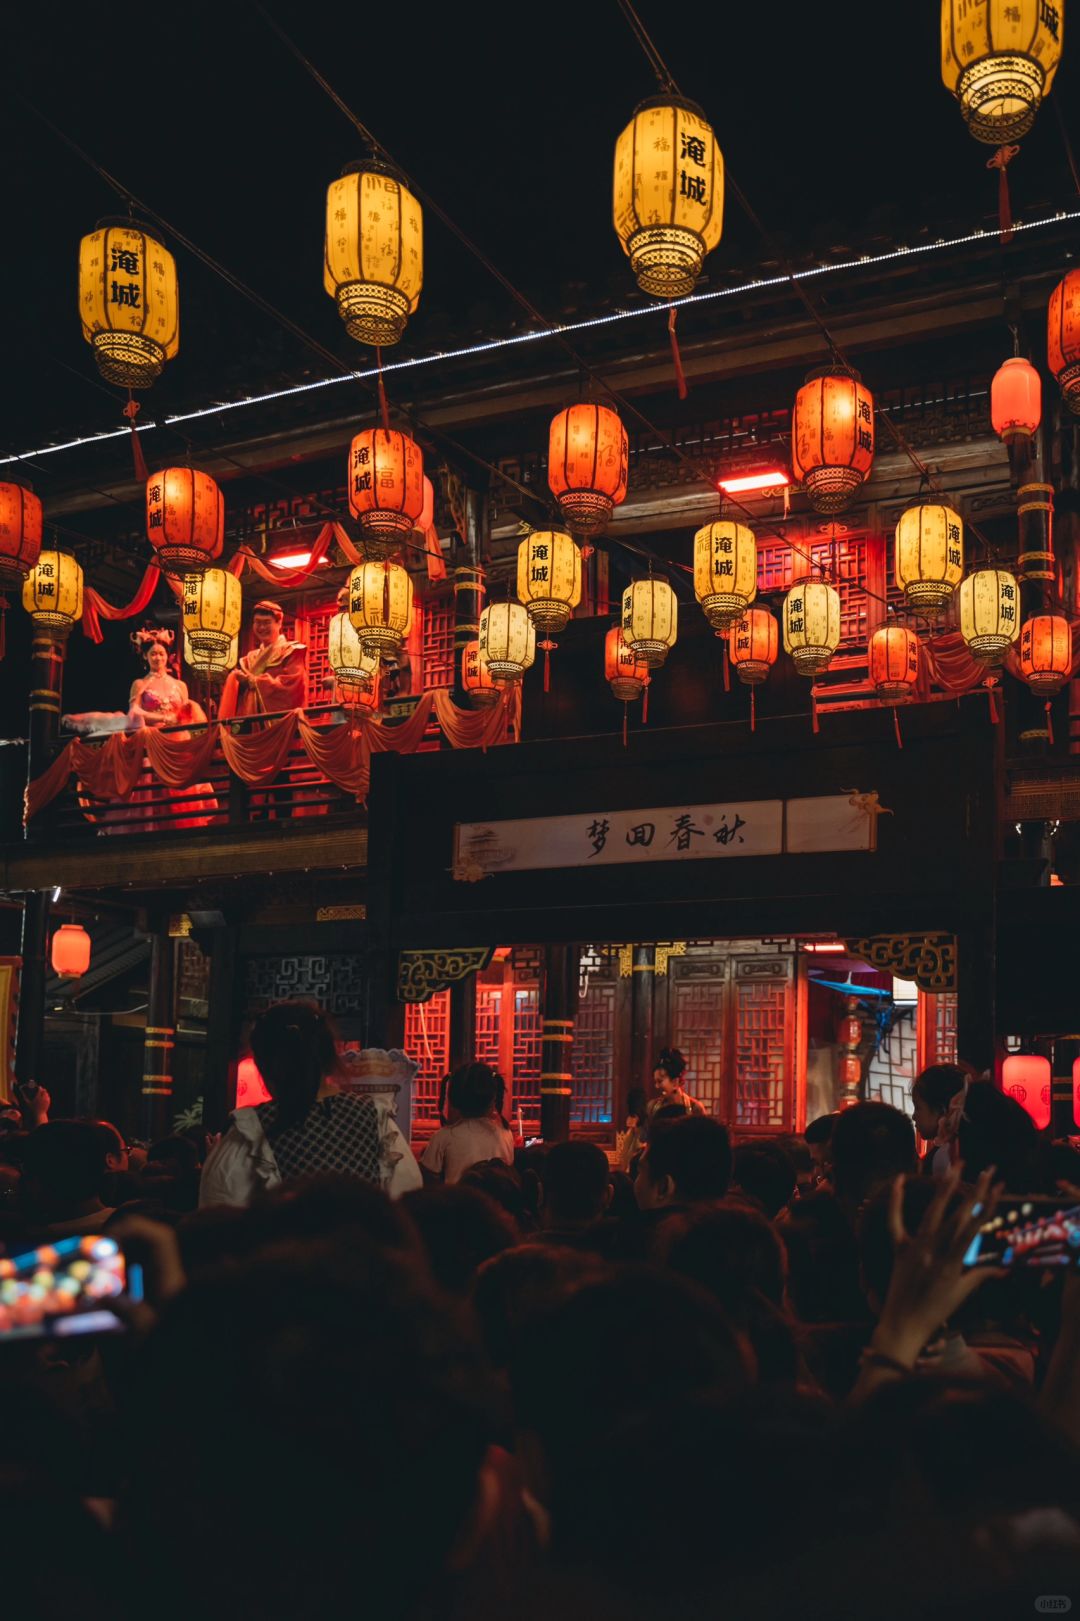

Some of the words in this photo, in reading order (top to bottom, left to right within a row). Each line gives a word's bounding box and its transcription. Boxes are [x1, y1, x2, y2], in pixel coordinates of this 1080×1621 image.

[680, 132, 706, 206] 淹城
[111, 248, 140, 308] 淹城
[858, 398, 873, 454] 淹城
[354, 447, 372, 493] 淹城
[149, 485, 163, 529] 淹城
[531, 545, 549, 582] 淹城
[715, 537, 733, 577] 淹城
[948, 523, 962, 569] 淹城
[38, 563, 55, 597] 淹城
[184, 581, 198, 616] 淹城
[351, 576, 362, 613] 淹城
[789, 598, 804, 634] 淹城
[1001, 584, 1015, 622] 淹城
[737, 620, 750, 650] 淹城
[1022, 631, 1031, 663] 淹城
[467, 651, 478, 678] 淹城
[908, 641, 917, 673] 淹城
[586, 814, 746, 858] 梦回春秋
